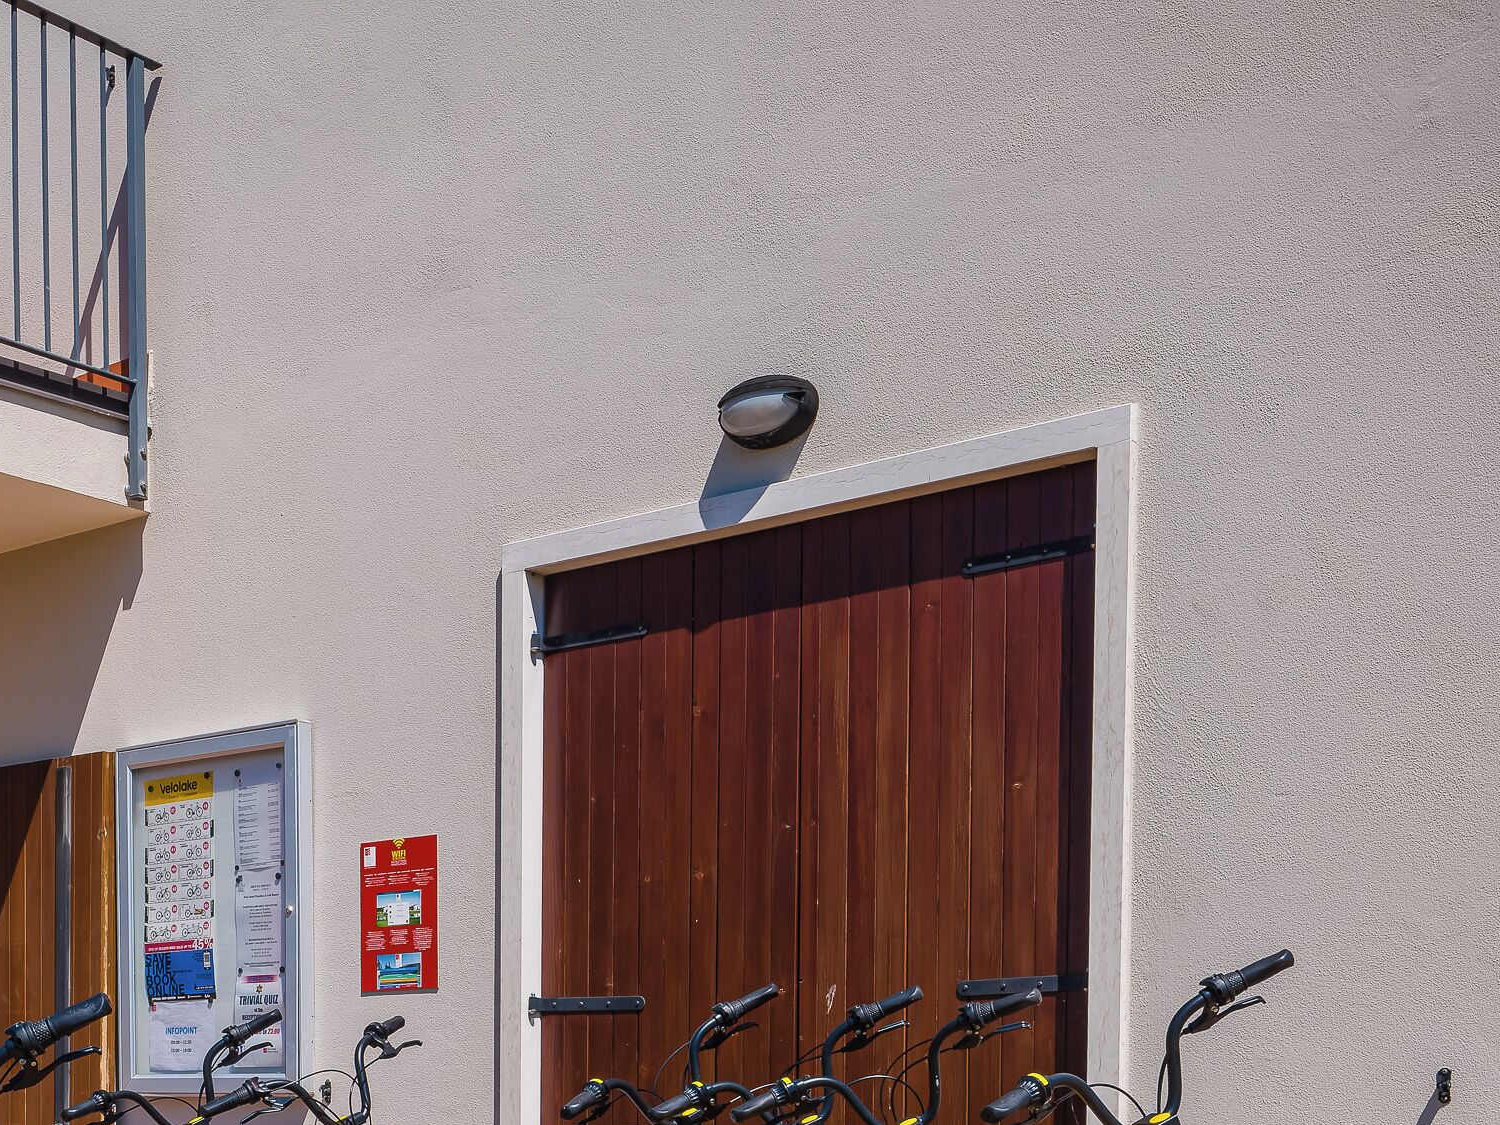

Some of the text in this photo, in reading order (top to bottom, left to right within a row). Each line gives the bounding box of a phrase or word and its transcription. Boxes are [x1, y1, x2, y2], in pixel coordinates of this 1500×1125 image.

[192, 938, 213, 950] 45%
[145, 952, 171, 966] SAVE
[145, 963, 171, 976] TIME
[146, 974, 177, 986] BOOK
[147, 984, 185, 997] ONLINE
[239, 994, 279, 1006] TRIVIAL QUIZ
[165, 1026, 198, 1035] INFOPOINT
